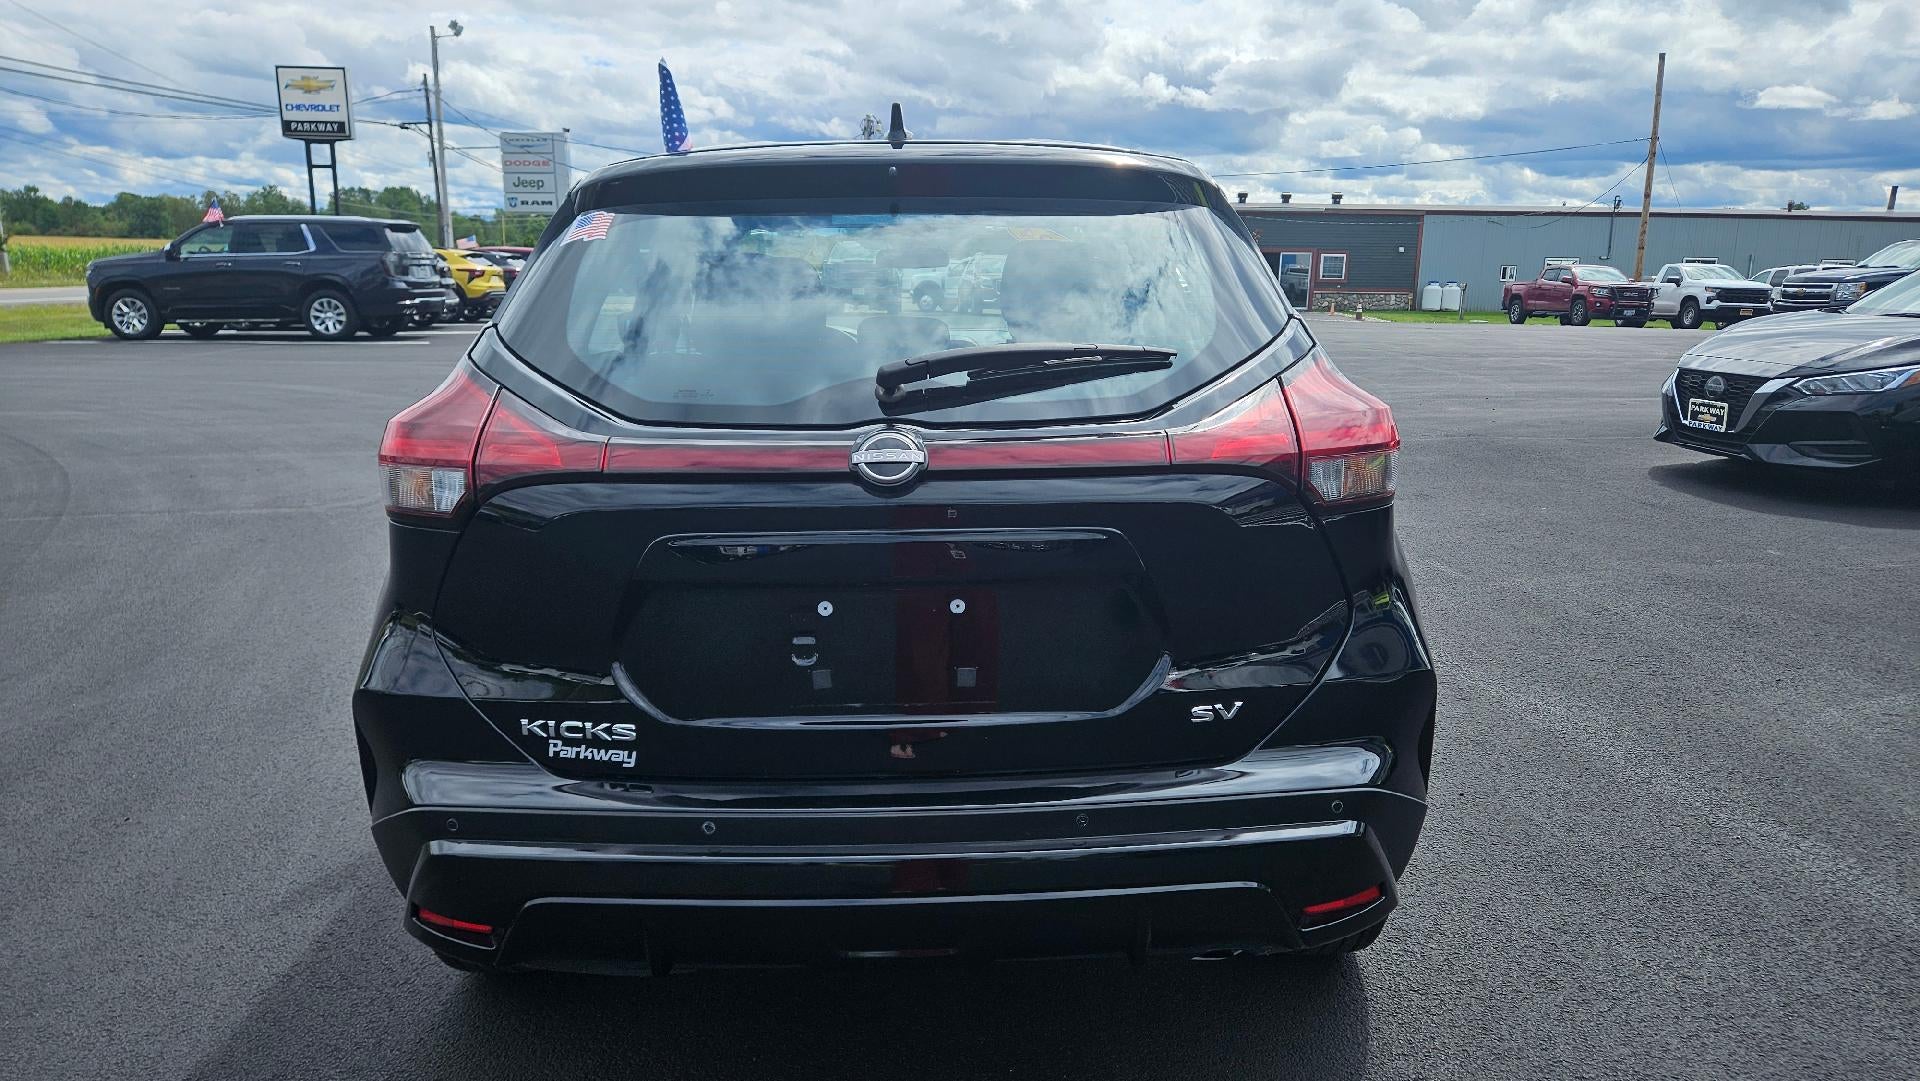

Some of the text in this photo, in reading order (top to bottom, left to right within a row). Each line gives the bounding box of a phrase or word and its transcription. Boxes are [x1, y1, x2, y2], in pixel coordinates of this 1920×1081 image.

[285, 104, 340, 112] CHEVROLET
[291, 122, 338, 131] PARKWAY
[513, 176, 544, 190] Jeep
[1691, 405, 1724, 415] PARKWAY
[854, 452, 922, 461] NISSAN
[1191, 702, 1243, 722] SV
[520, 719, 636, 740] KICKS
[549, 740, 636, 767] Parkway
